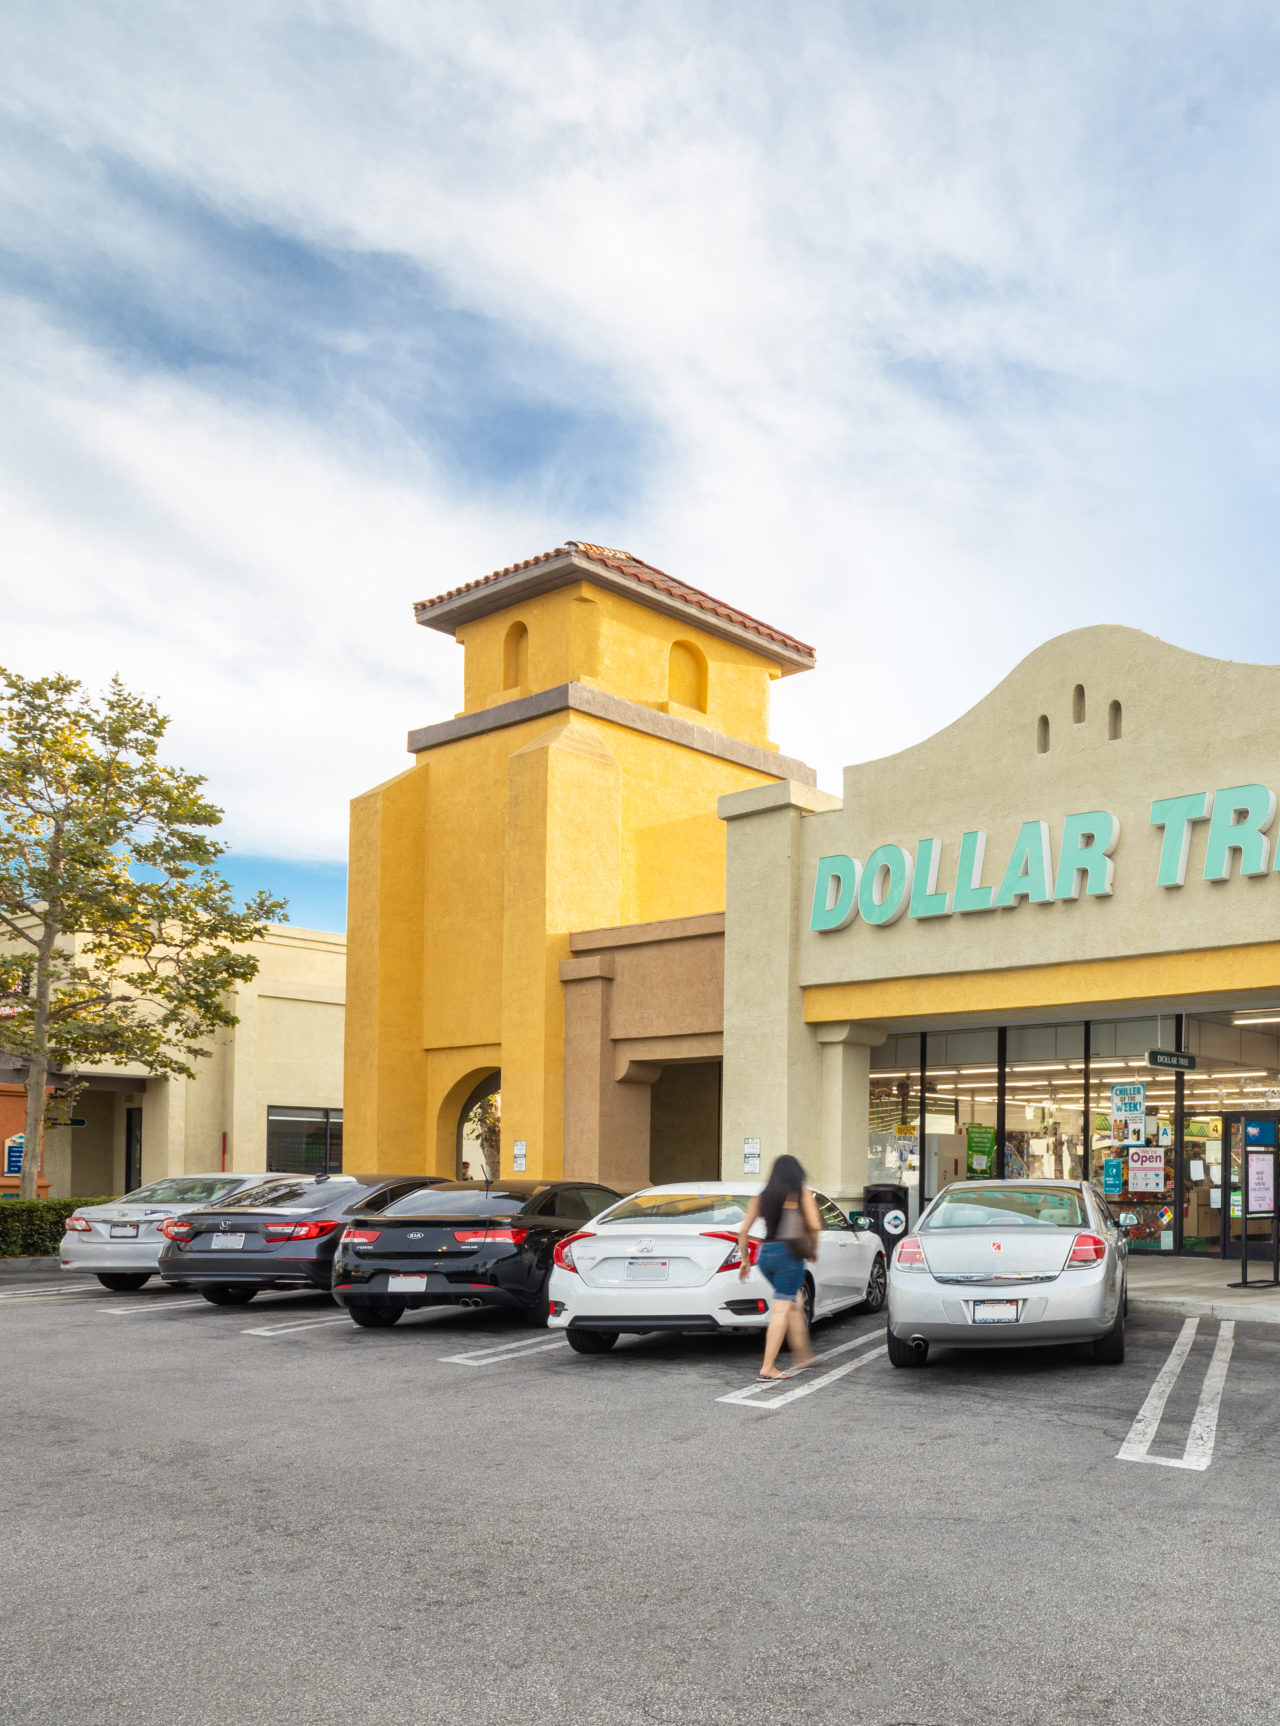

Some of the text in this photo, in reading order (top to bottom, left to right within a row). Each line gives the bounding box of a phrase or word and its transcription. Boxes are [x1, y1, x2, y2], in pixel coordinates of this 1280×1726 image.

[810, 810, 1120, 932] DOLLAR
[1157, 1055, 1189, 1066] DOLLAR TREE
[1114, 1086, 1141, 1097] CHILLER
[1115, 1101, 1142, 1113] WEEK!
[1161, 1127, 1169, 1137] A
[1212, 1124, 1219, 1134] 4
[1130, 1151, 1162, 1166] Open
